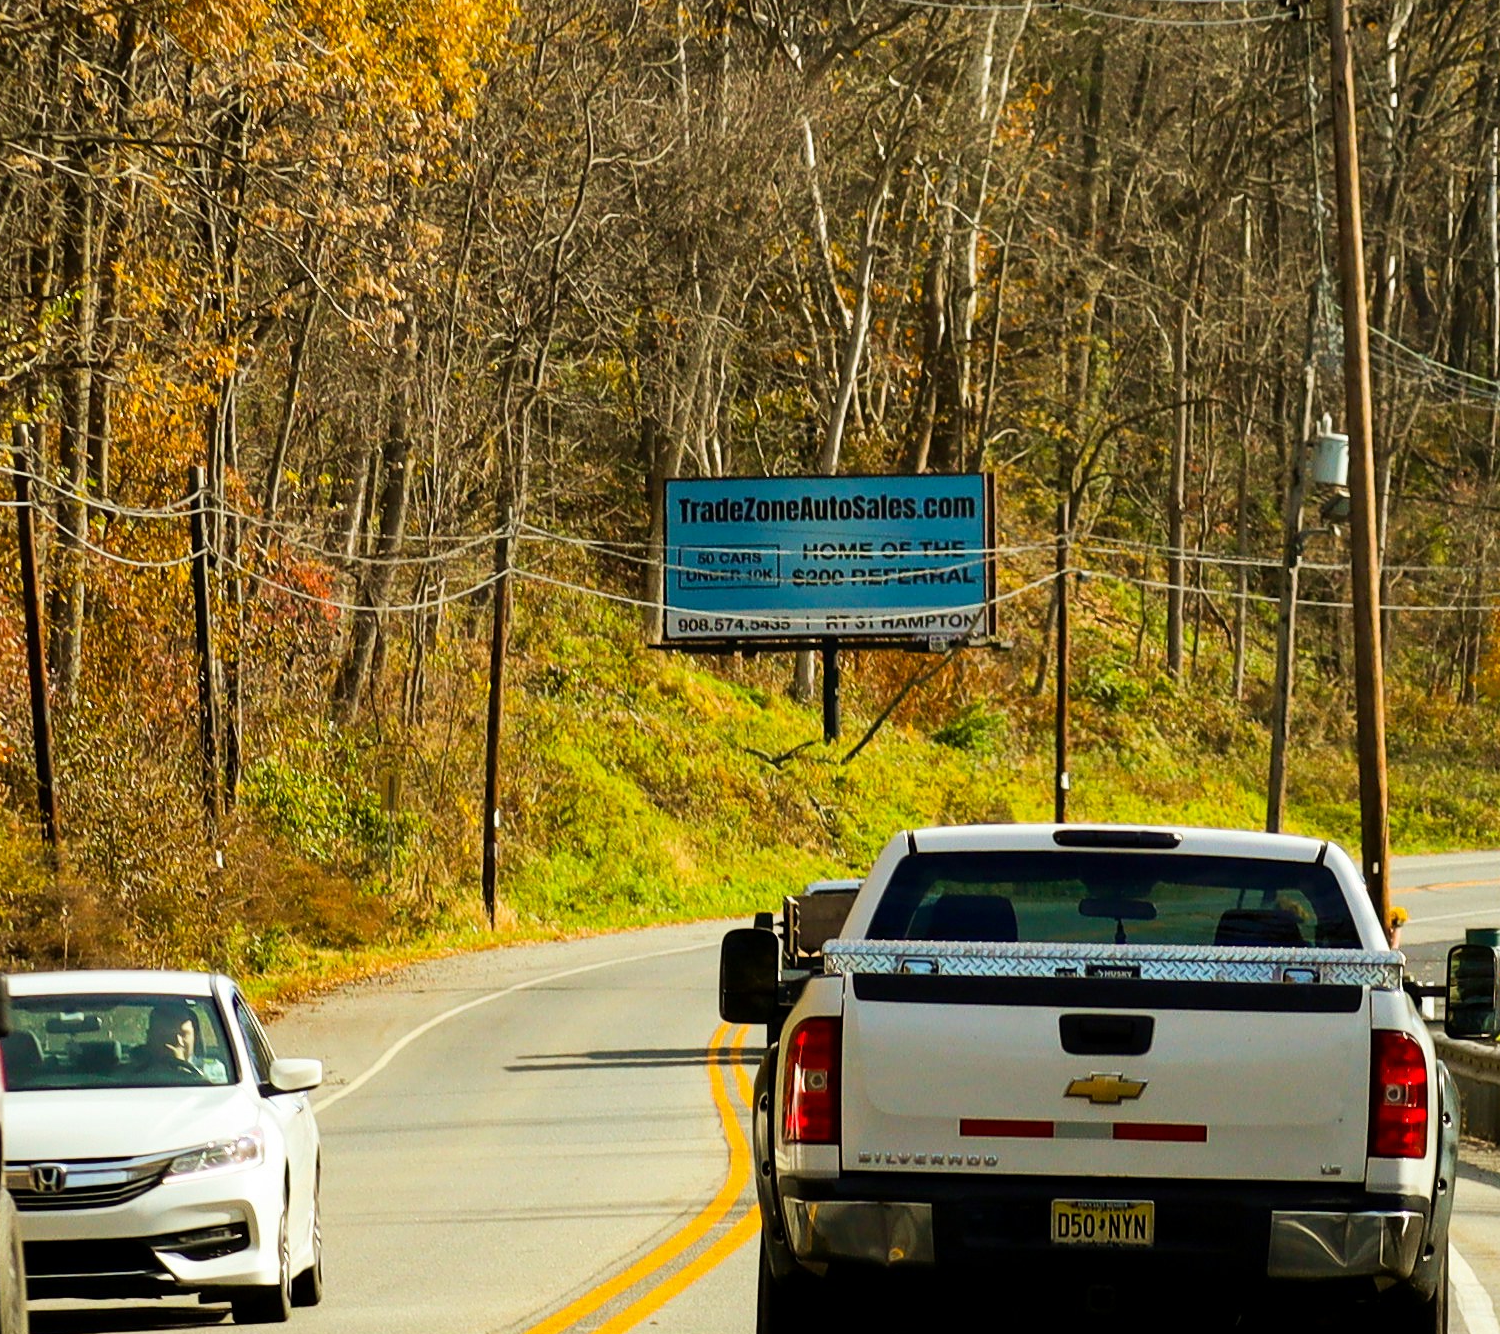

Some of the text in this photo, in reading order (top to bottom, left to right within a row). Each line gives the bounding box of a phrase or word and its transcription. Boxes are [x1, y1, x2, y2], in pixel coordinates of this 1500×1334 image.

[678, 494, 976, 524] TradeZoneAutoSales.com
[697, 551, 762, 565] 50 CARS
[803, 540, 966, 560] HOME OF THE
[686, 569, 741, 583] UNDER
[792, 567, 977, 587] $200 REFERRAL
[678, 616, 791, 633] 908.574.5435
[881, 613, 977, 630] HAMPTON
[858, 1151, 999, 1167] SILVERADO
[1058, 1213, 1147, 1239] D50 NYN
